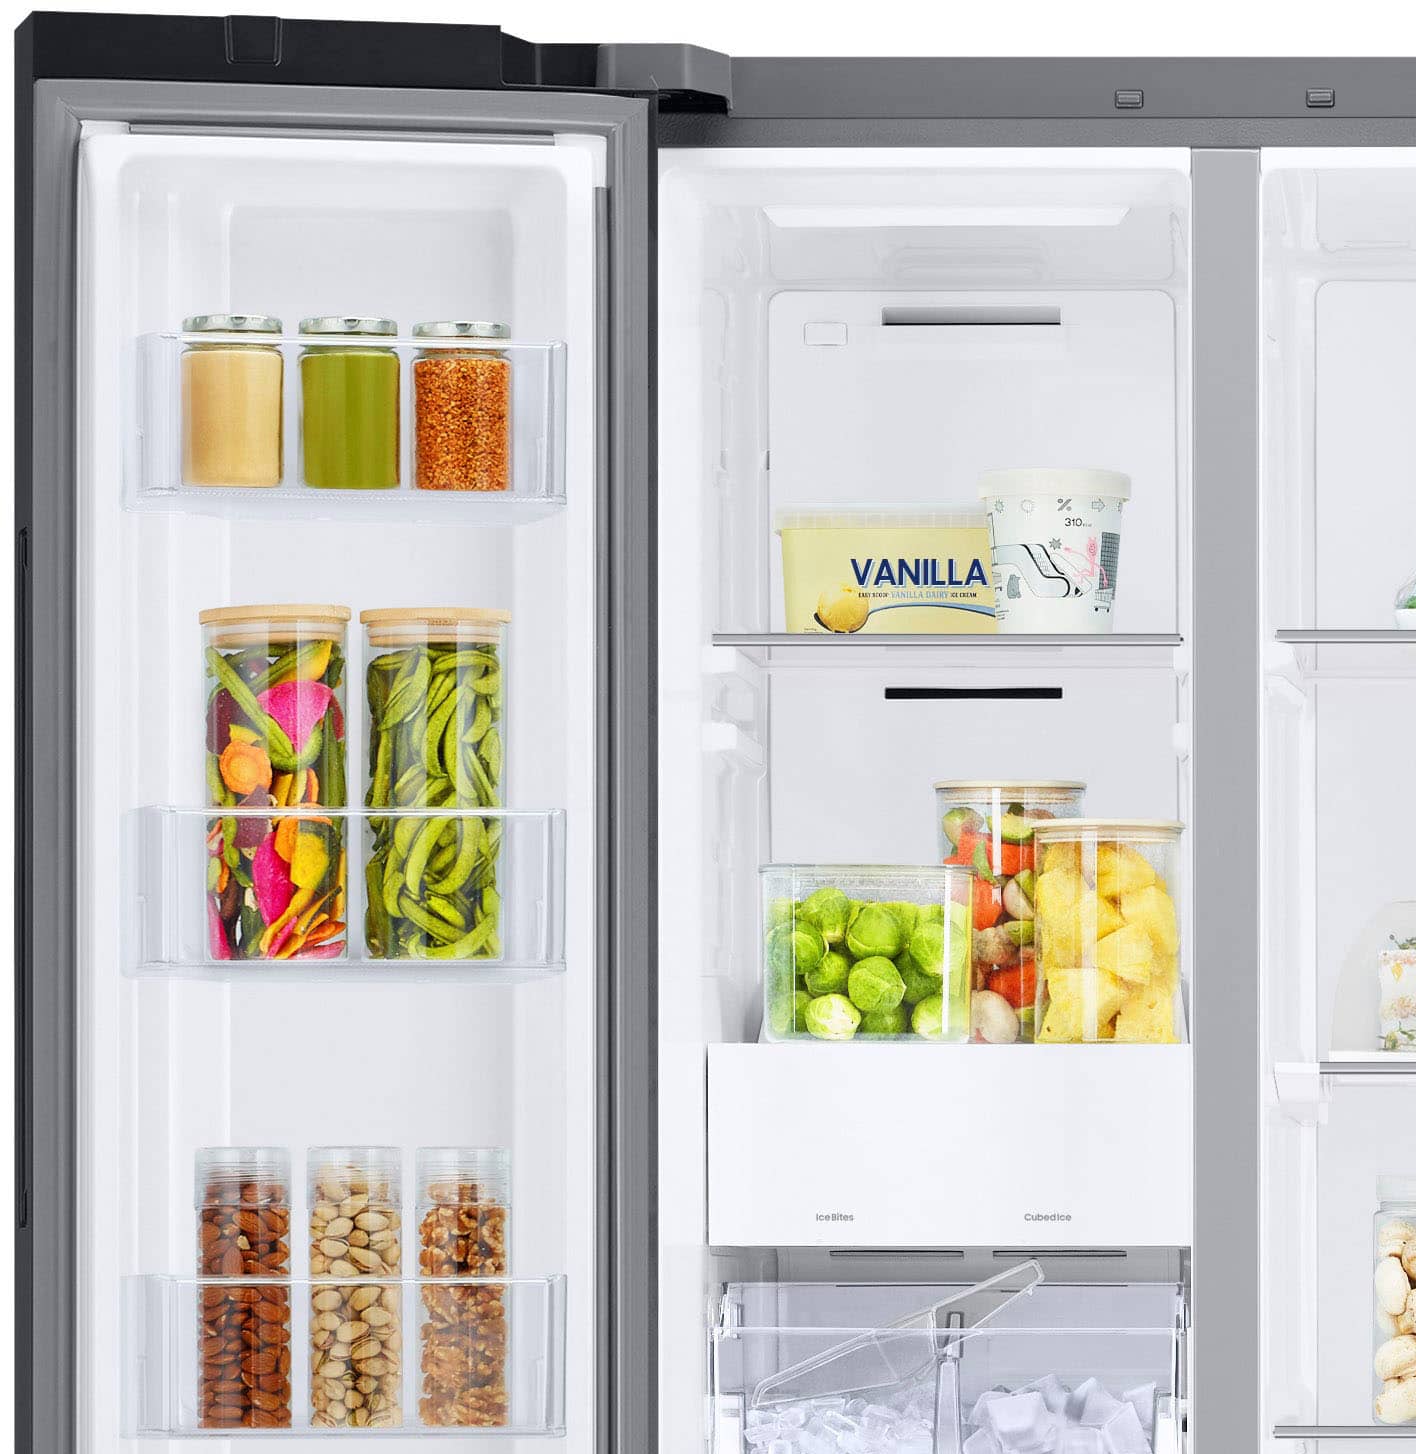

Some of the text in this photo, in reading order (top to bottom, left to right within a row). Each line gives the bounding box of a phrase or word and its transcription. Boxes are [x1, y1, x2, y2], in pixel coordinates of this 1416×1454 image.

[1064, 518, 1083, 527] 310
[850, 558, 990, 587] VANILLA
[891, 591, 924, 599] VANILLA
[926, 591, 948, 599] DAIRY
[816, 1213, 854, 1221] Ice Bites
[1024, 1213, 1056, 1221] Cubed
